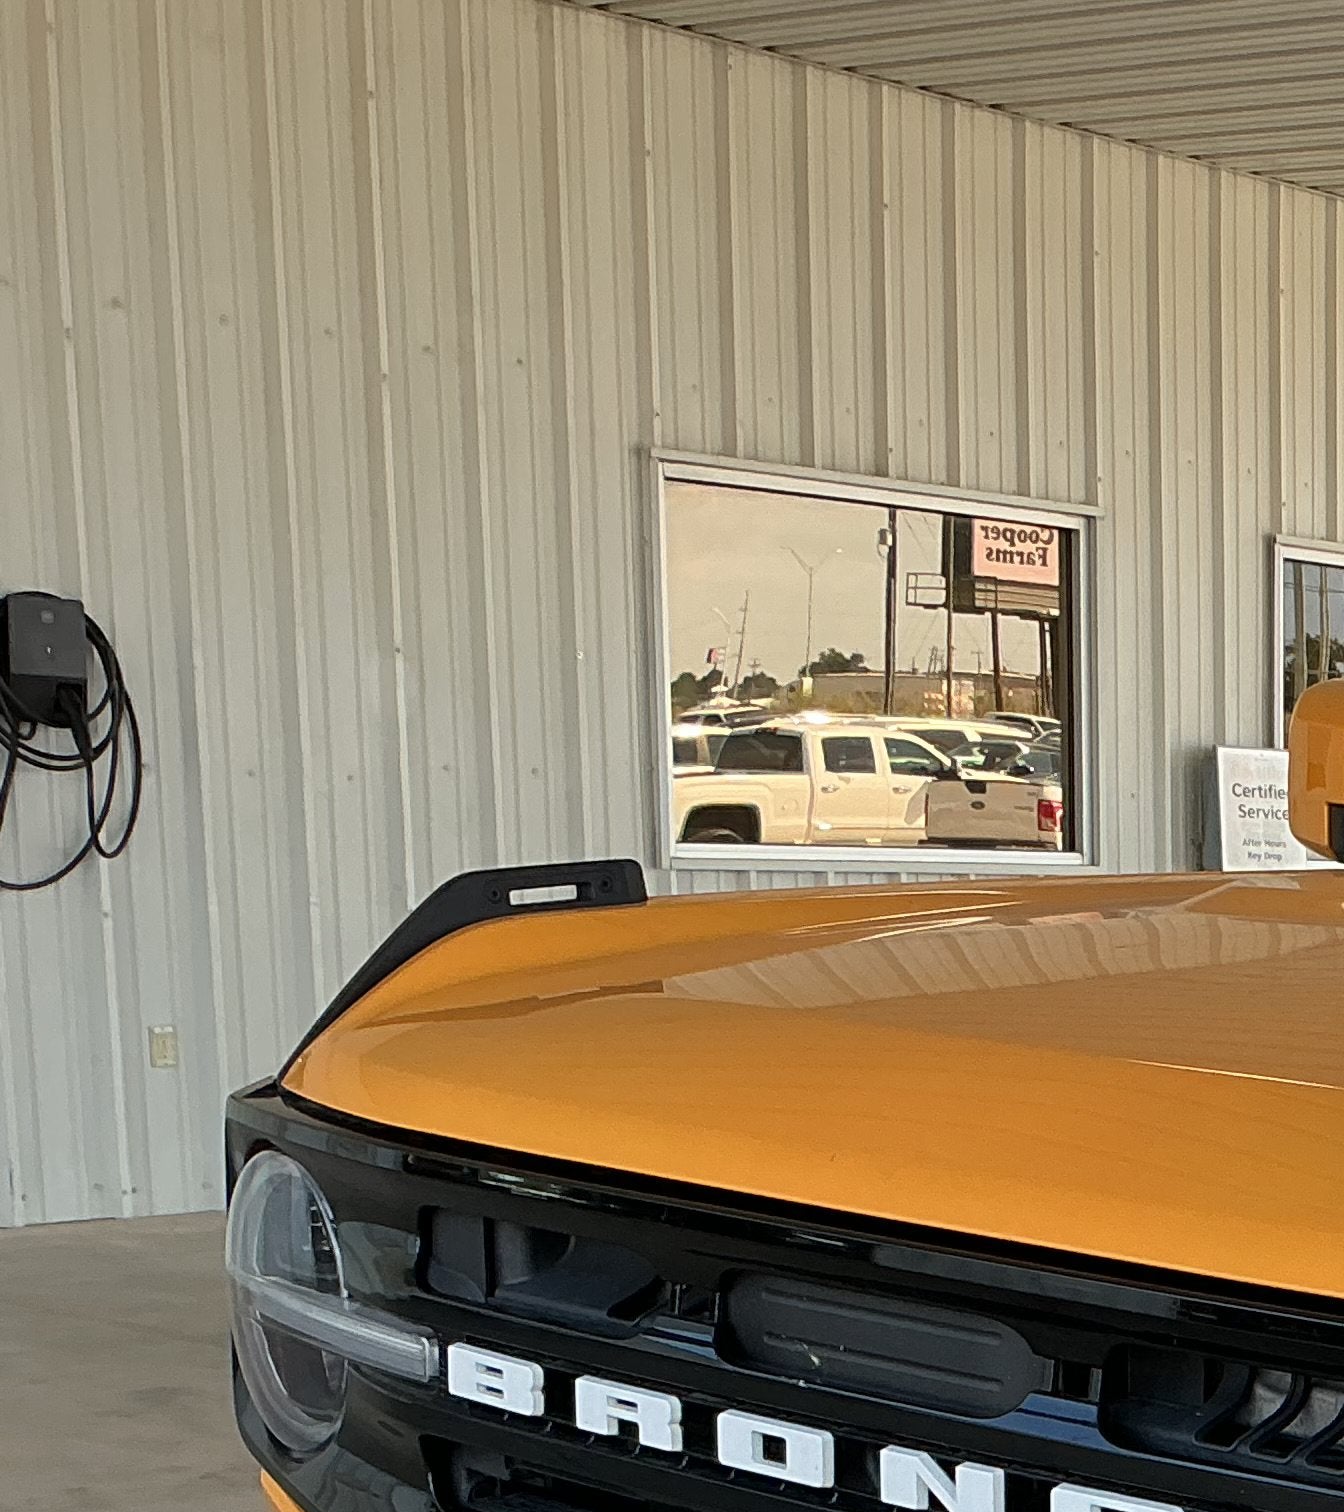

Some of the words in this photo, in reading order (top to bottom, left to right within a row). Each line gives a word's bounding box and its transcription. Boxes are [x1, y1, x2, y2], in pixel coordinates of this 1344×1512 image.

[1231, 782, 1289, 800] Certifie
[1238, 804, 1289, 821] Service
[1242, 837, 1262, 848] After
[1247, 852, 1262, 862] Key
[1264, 851, 1283, 862] Drop
